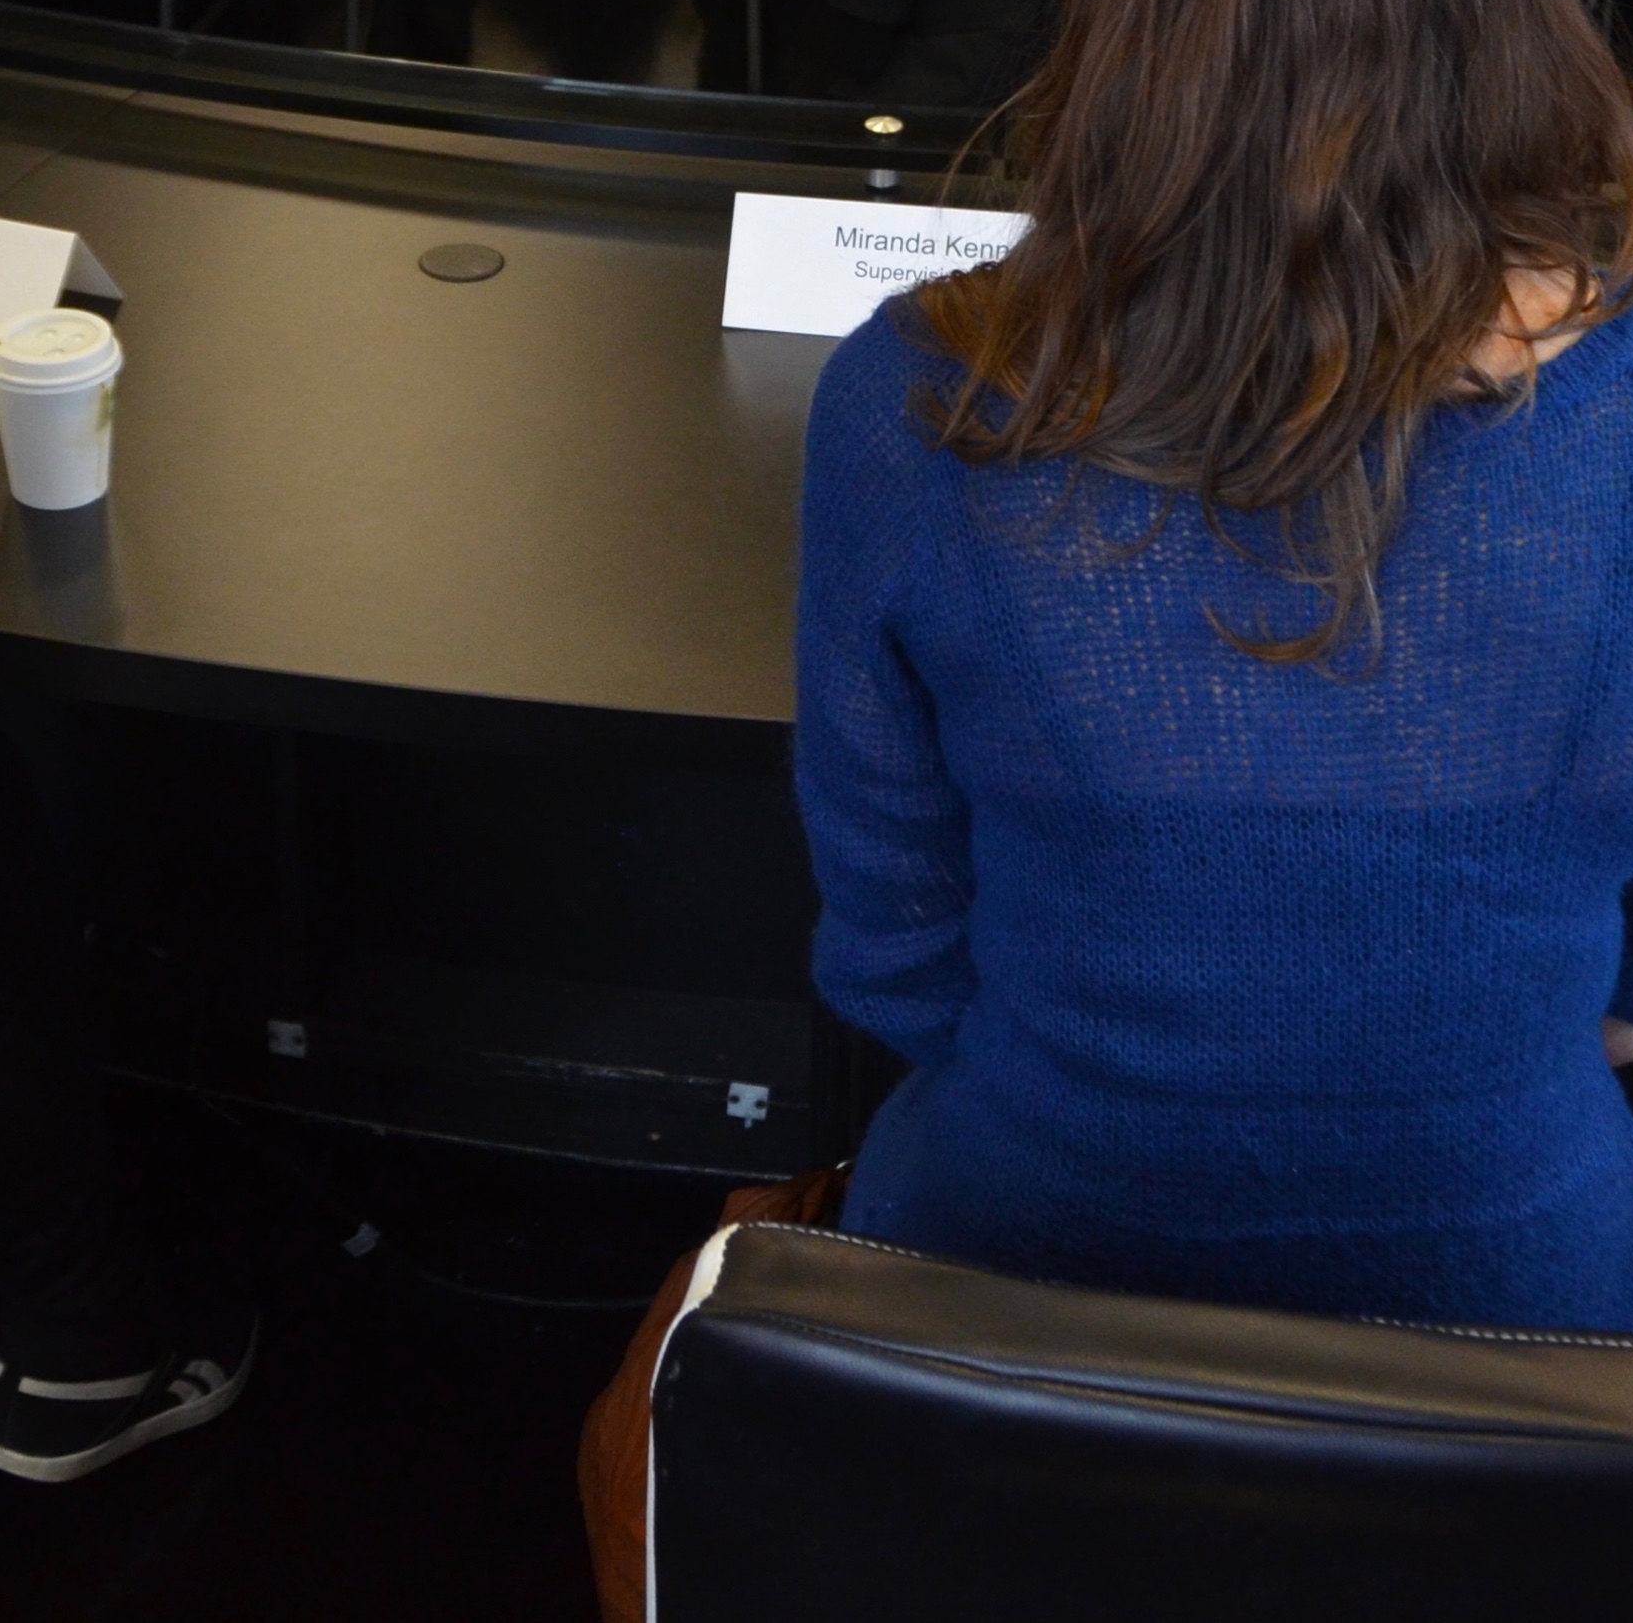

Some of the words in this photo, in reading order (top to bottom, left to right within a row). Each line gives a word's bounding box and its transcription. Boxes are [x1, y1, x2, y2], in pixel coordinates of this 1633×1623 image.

[835, 226, 935, 255] Miranda
[945, 235, 1010, 260] Kenn
[854, 261, 944, 283] Supervisi
